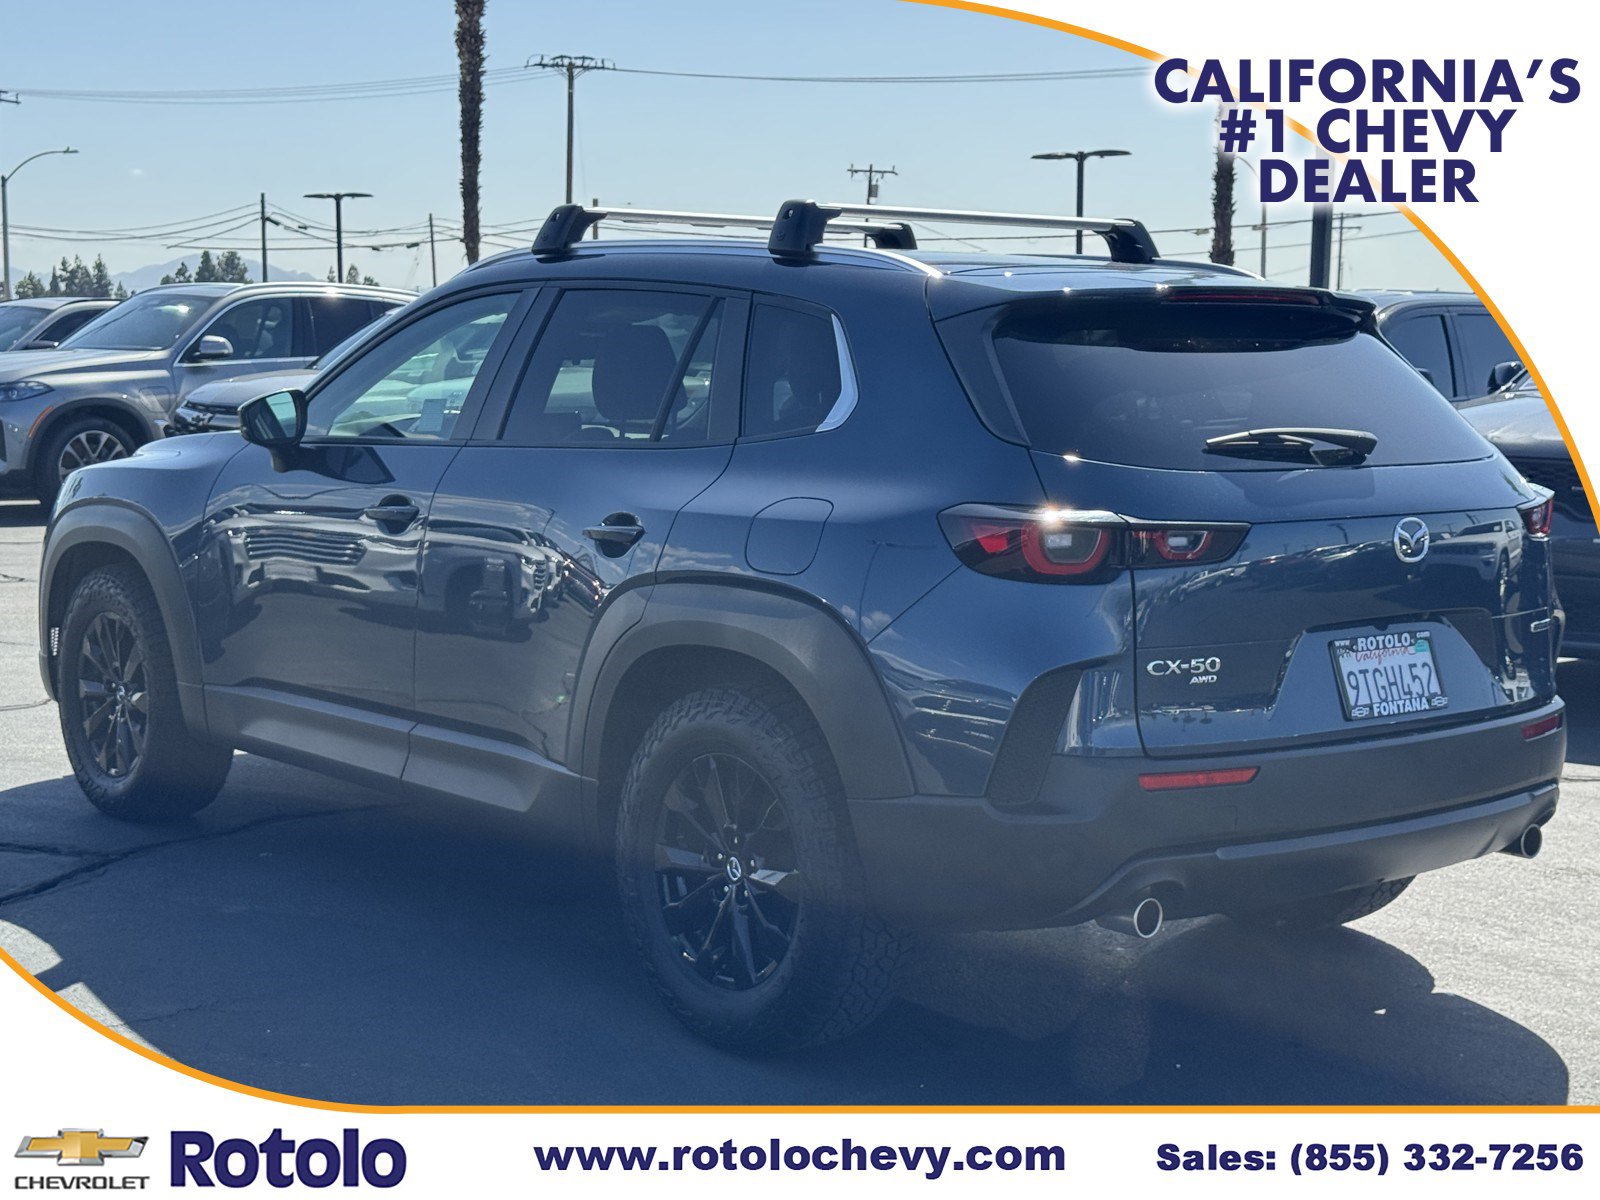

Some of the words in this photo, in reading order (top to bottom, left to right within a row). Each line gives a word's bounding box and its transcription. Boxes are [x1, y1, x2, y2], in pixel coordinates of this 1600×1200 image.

[1146, 656, 1221, 676] CX-50
[1189, 674, 1218, 685] AWD
[1372, 697, 1429, 717] FONTANA
